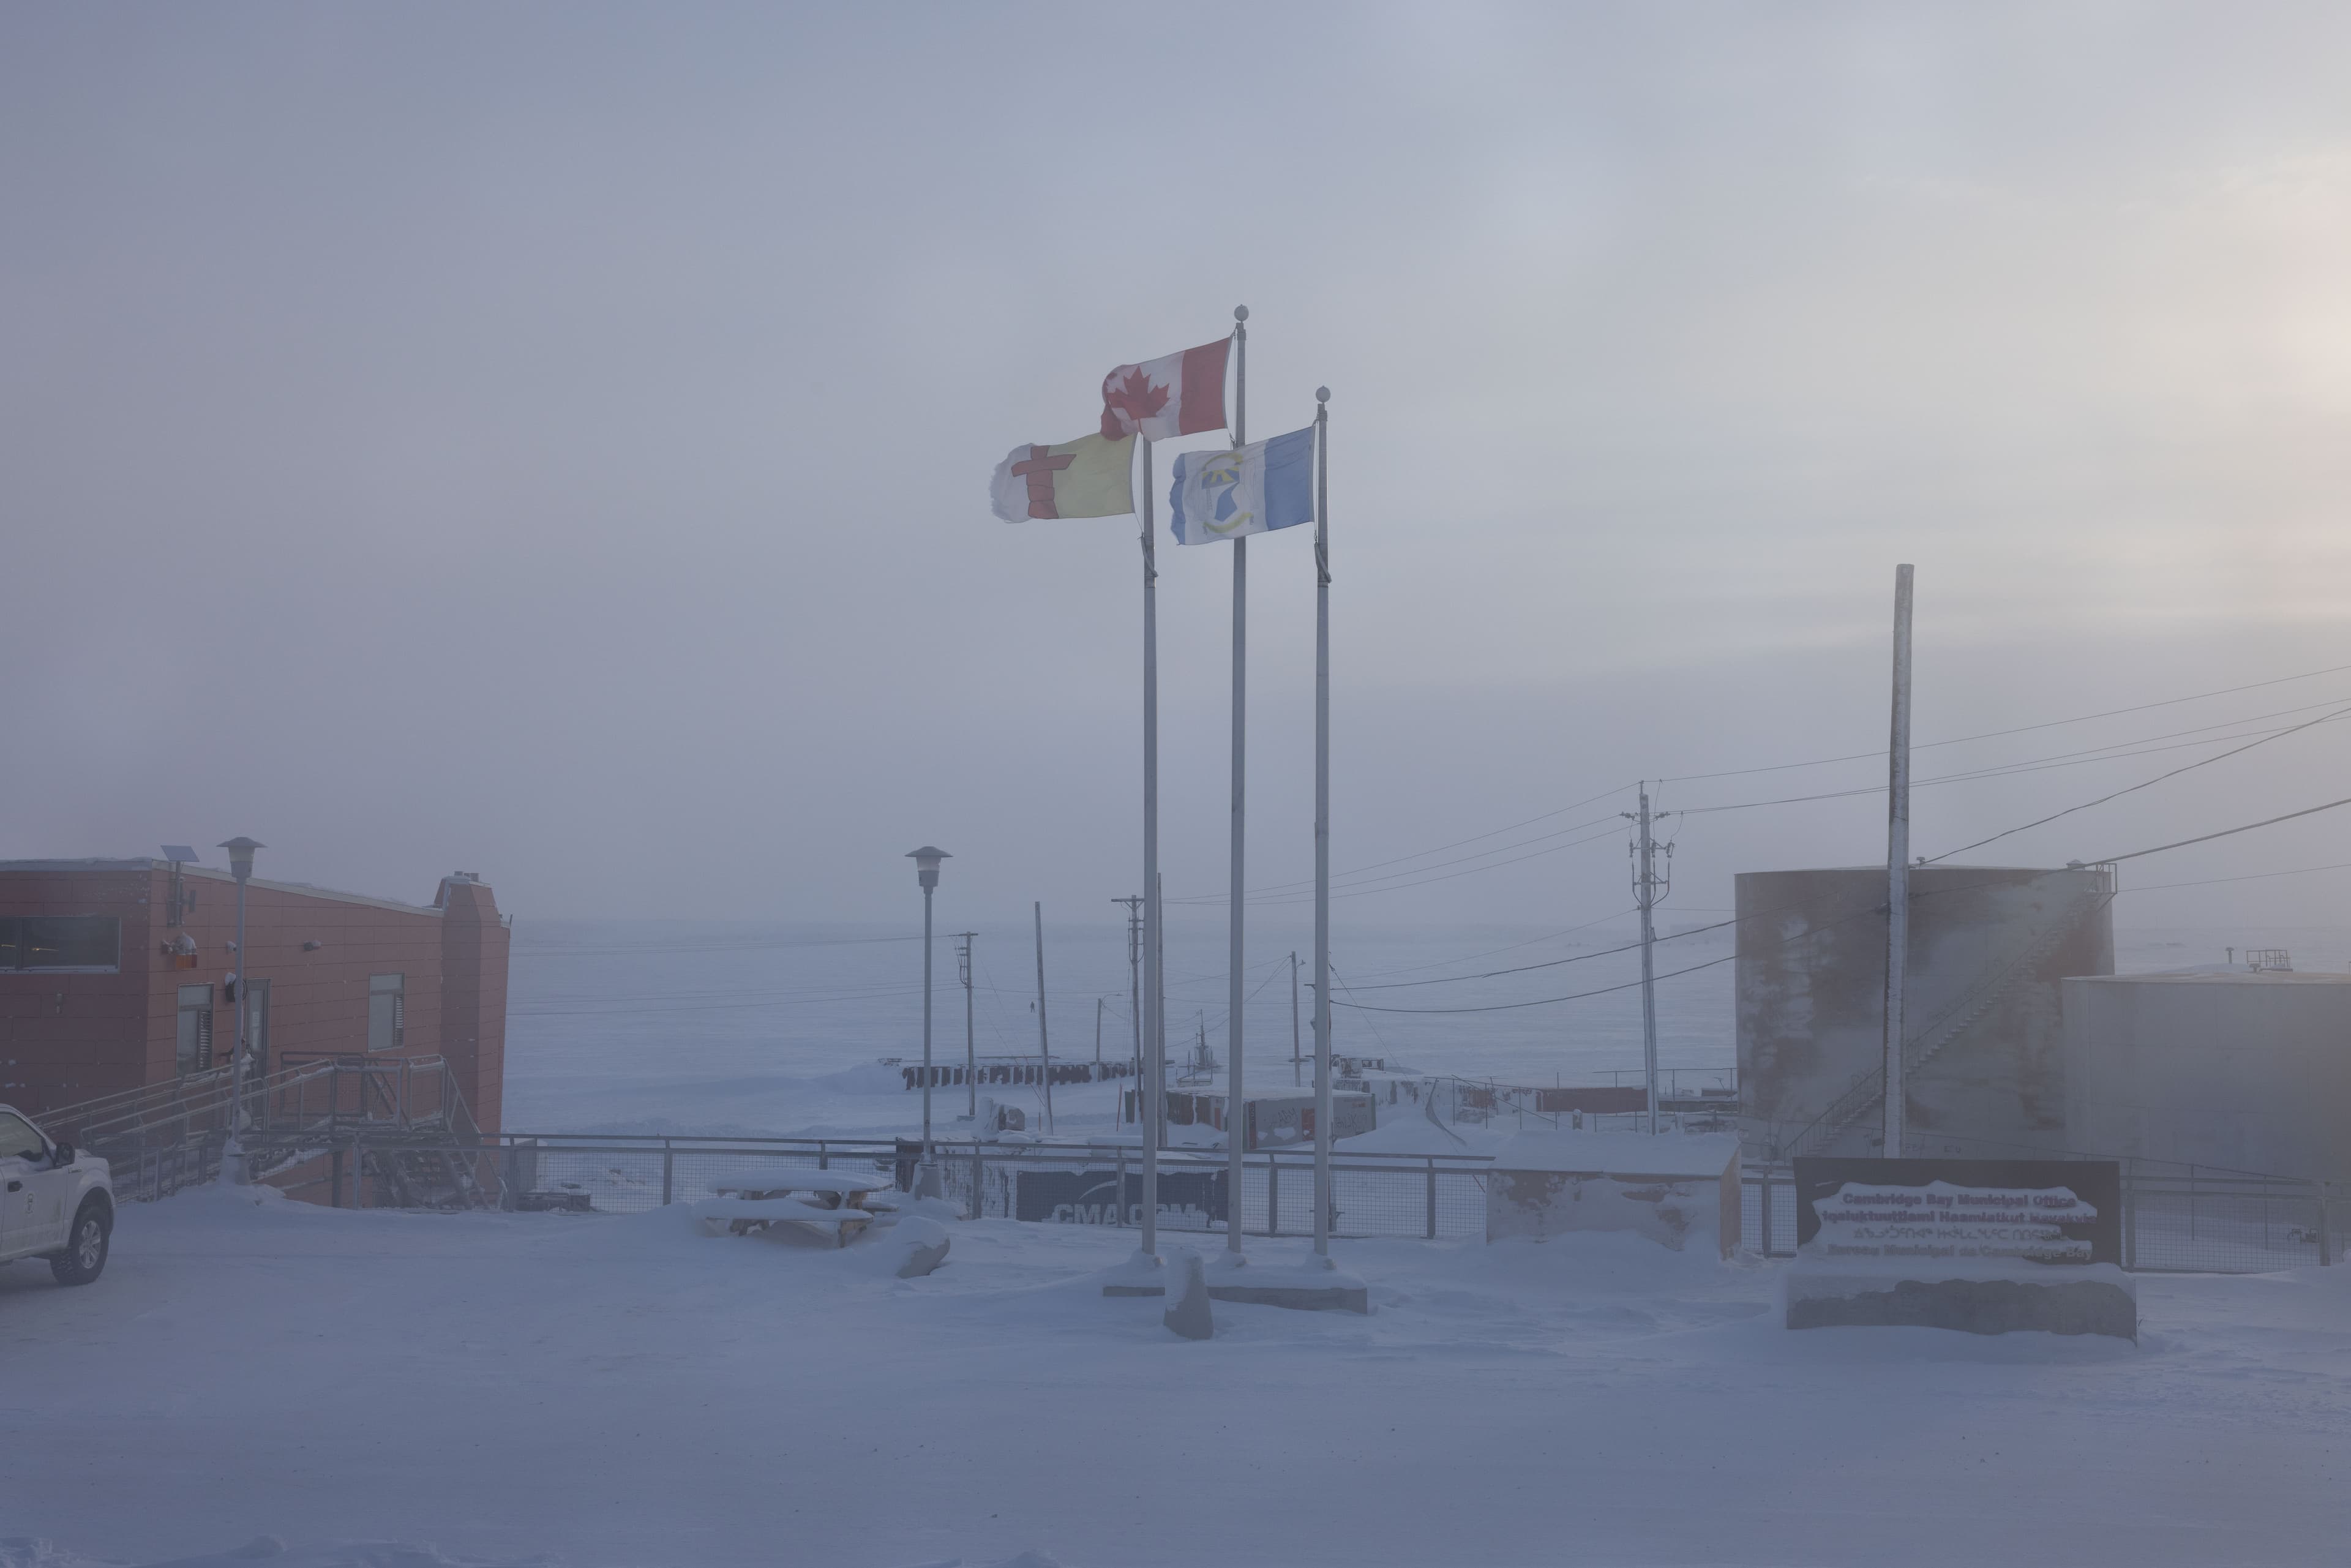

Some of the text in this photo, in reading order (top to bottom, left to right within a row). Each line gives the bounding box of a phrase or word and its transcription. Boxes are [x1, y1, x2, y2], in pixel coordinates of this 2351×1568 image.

[1843, 1193, 2076, 1208] Cambridge Bay Municipal Office
[1884, 1244, 1954, 1258] Municipal
[1982, 1246, 2061, 1259] Cambridge
[2066, 1247, 2091, 1260] Bay
